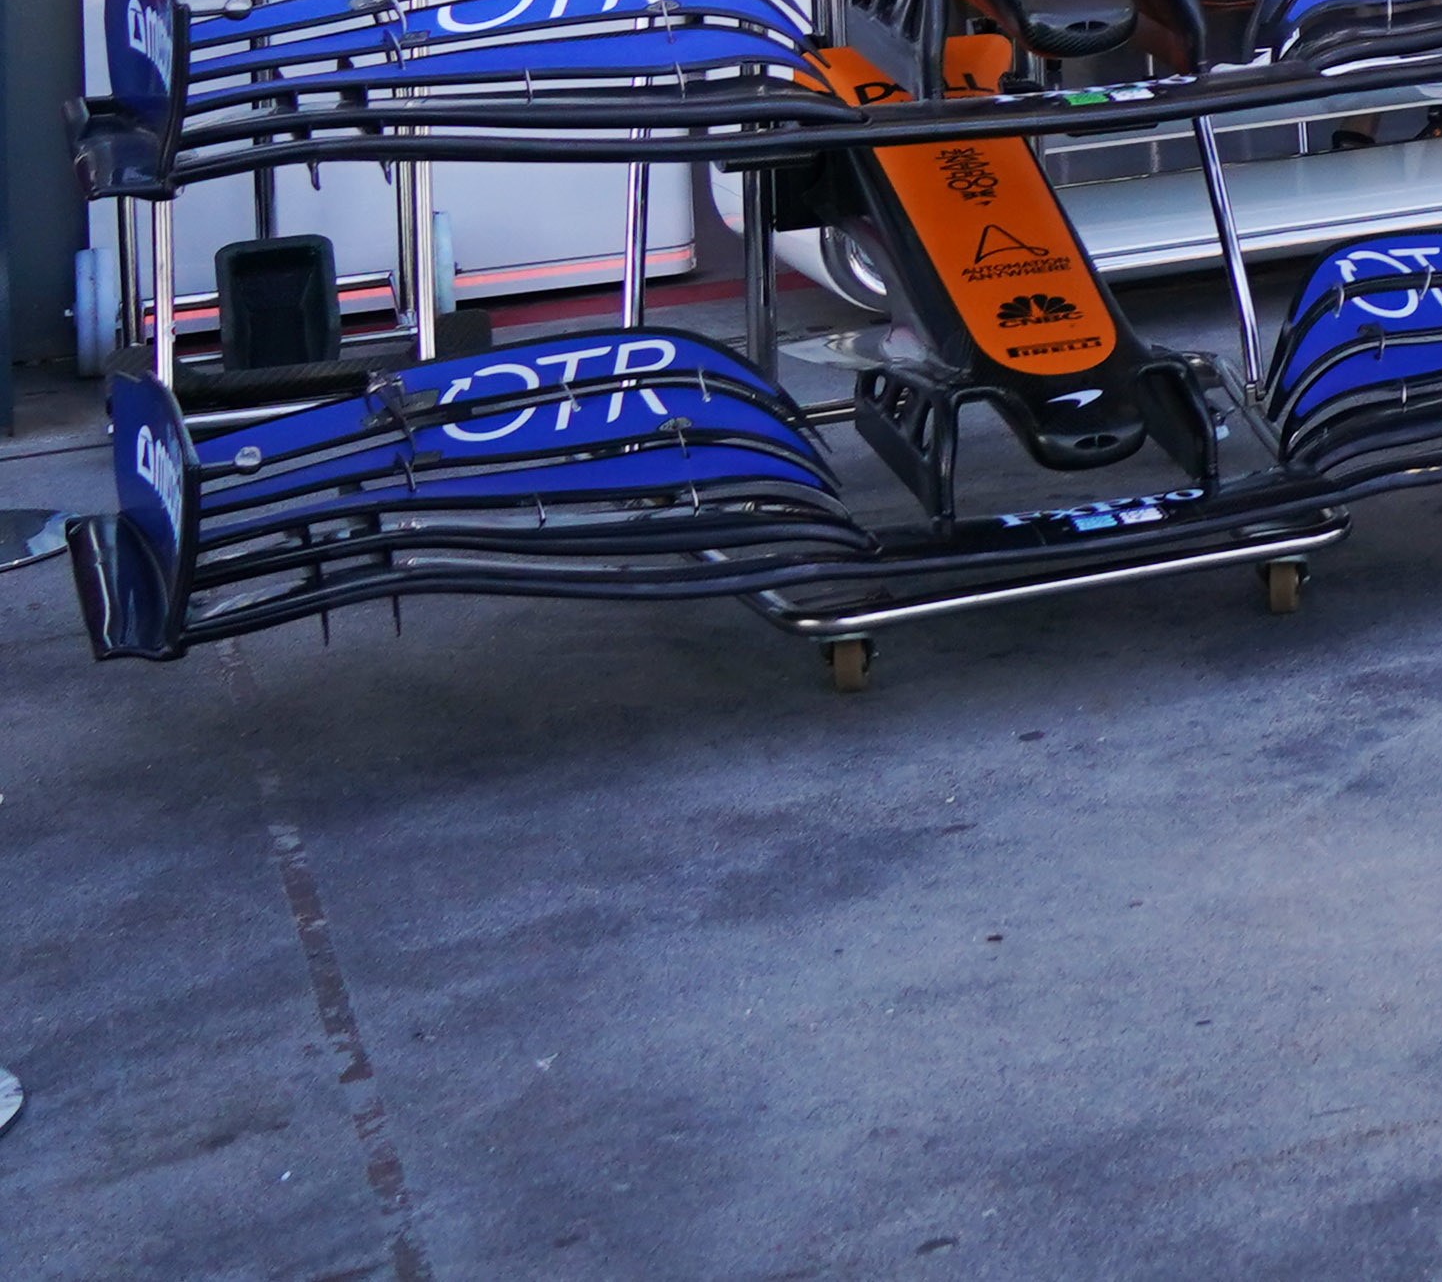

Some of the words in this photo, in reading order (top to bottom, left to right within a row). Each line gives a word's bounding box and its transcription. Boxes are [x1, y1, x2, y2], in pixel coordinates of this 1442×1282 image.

[853, 72, 995, 106] DLL
[961, 256, 1072, 277] AUTOMATION
[967, 262, 1073, 283] ANYWHERE
[998, 310, 1084, 328] CNBC
[1006, 336, 1102, 358] PIRELLI
